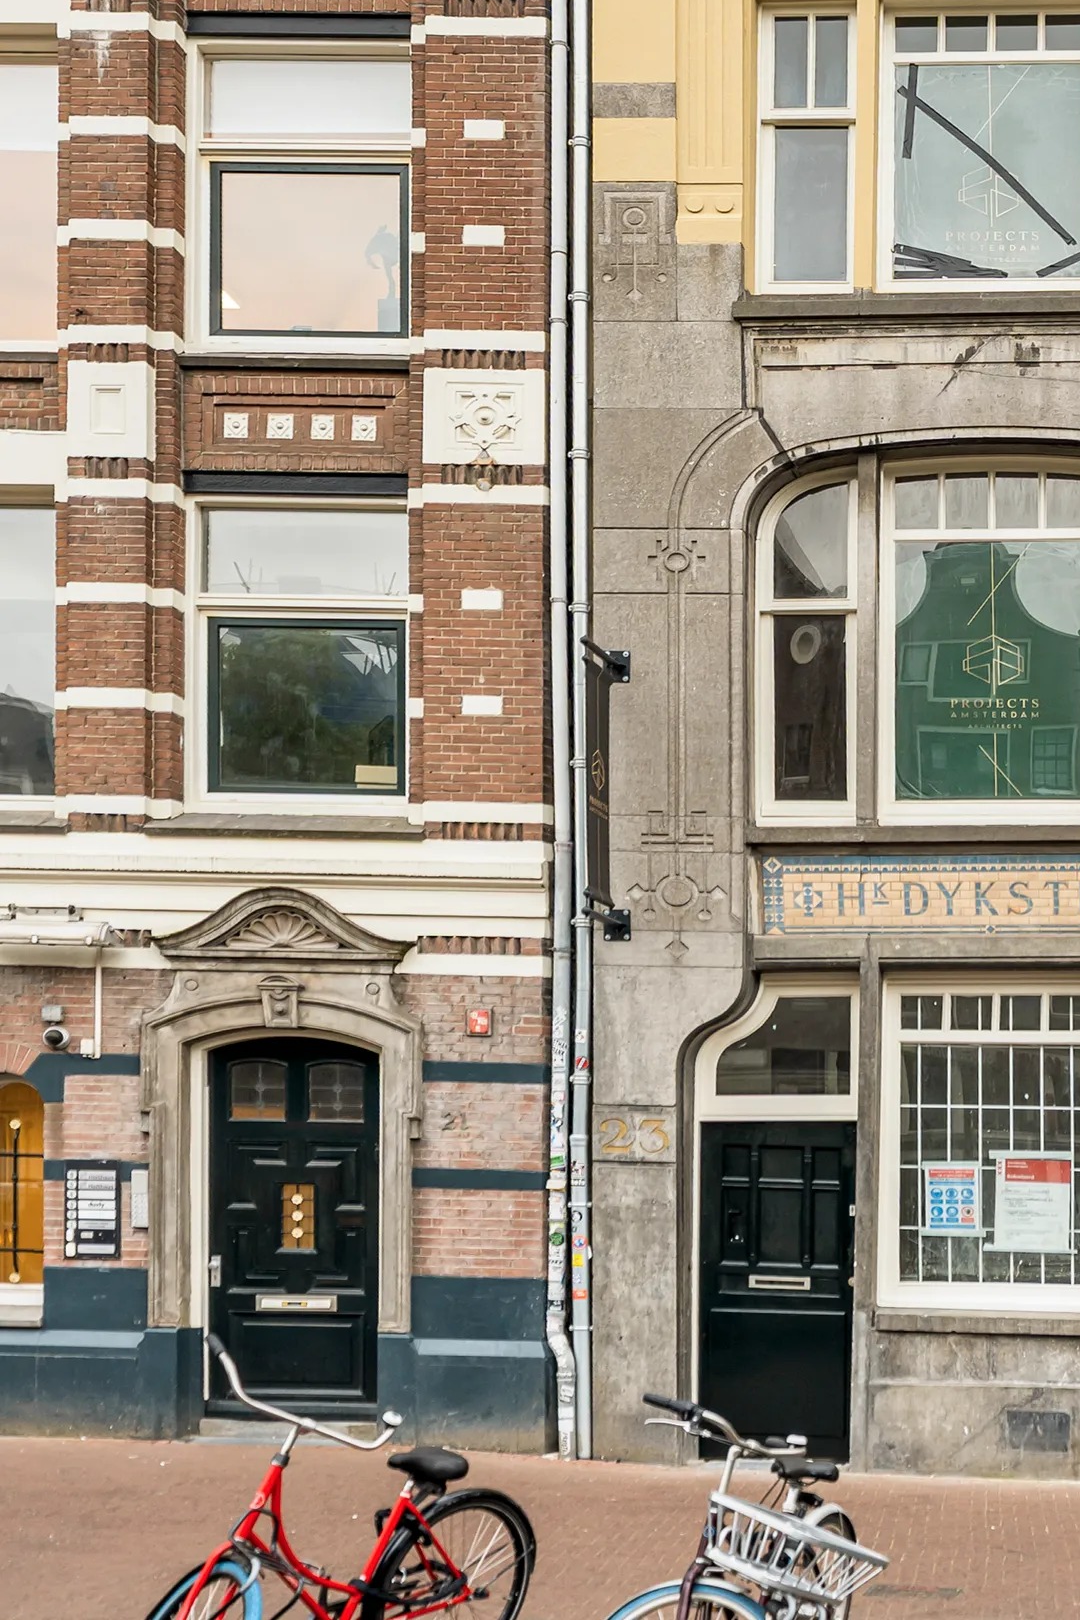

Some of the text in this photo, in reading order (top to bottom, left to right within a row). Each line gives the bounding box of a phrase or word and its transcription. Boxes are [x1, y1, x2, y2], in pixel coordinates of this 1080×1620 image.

[945, 230, 1039, 241] PROJECTS
[950, 698, 1040, 709] PROJECTS
[950, 711, 1040, 719] AMSTERDAM
[599, 1118, 670, 1154] 23
